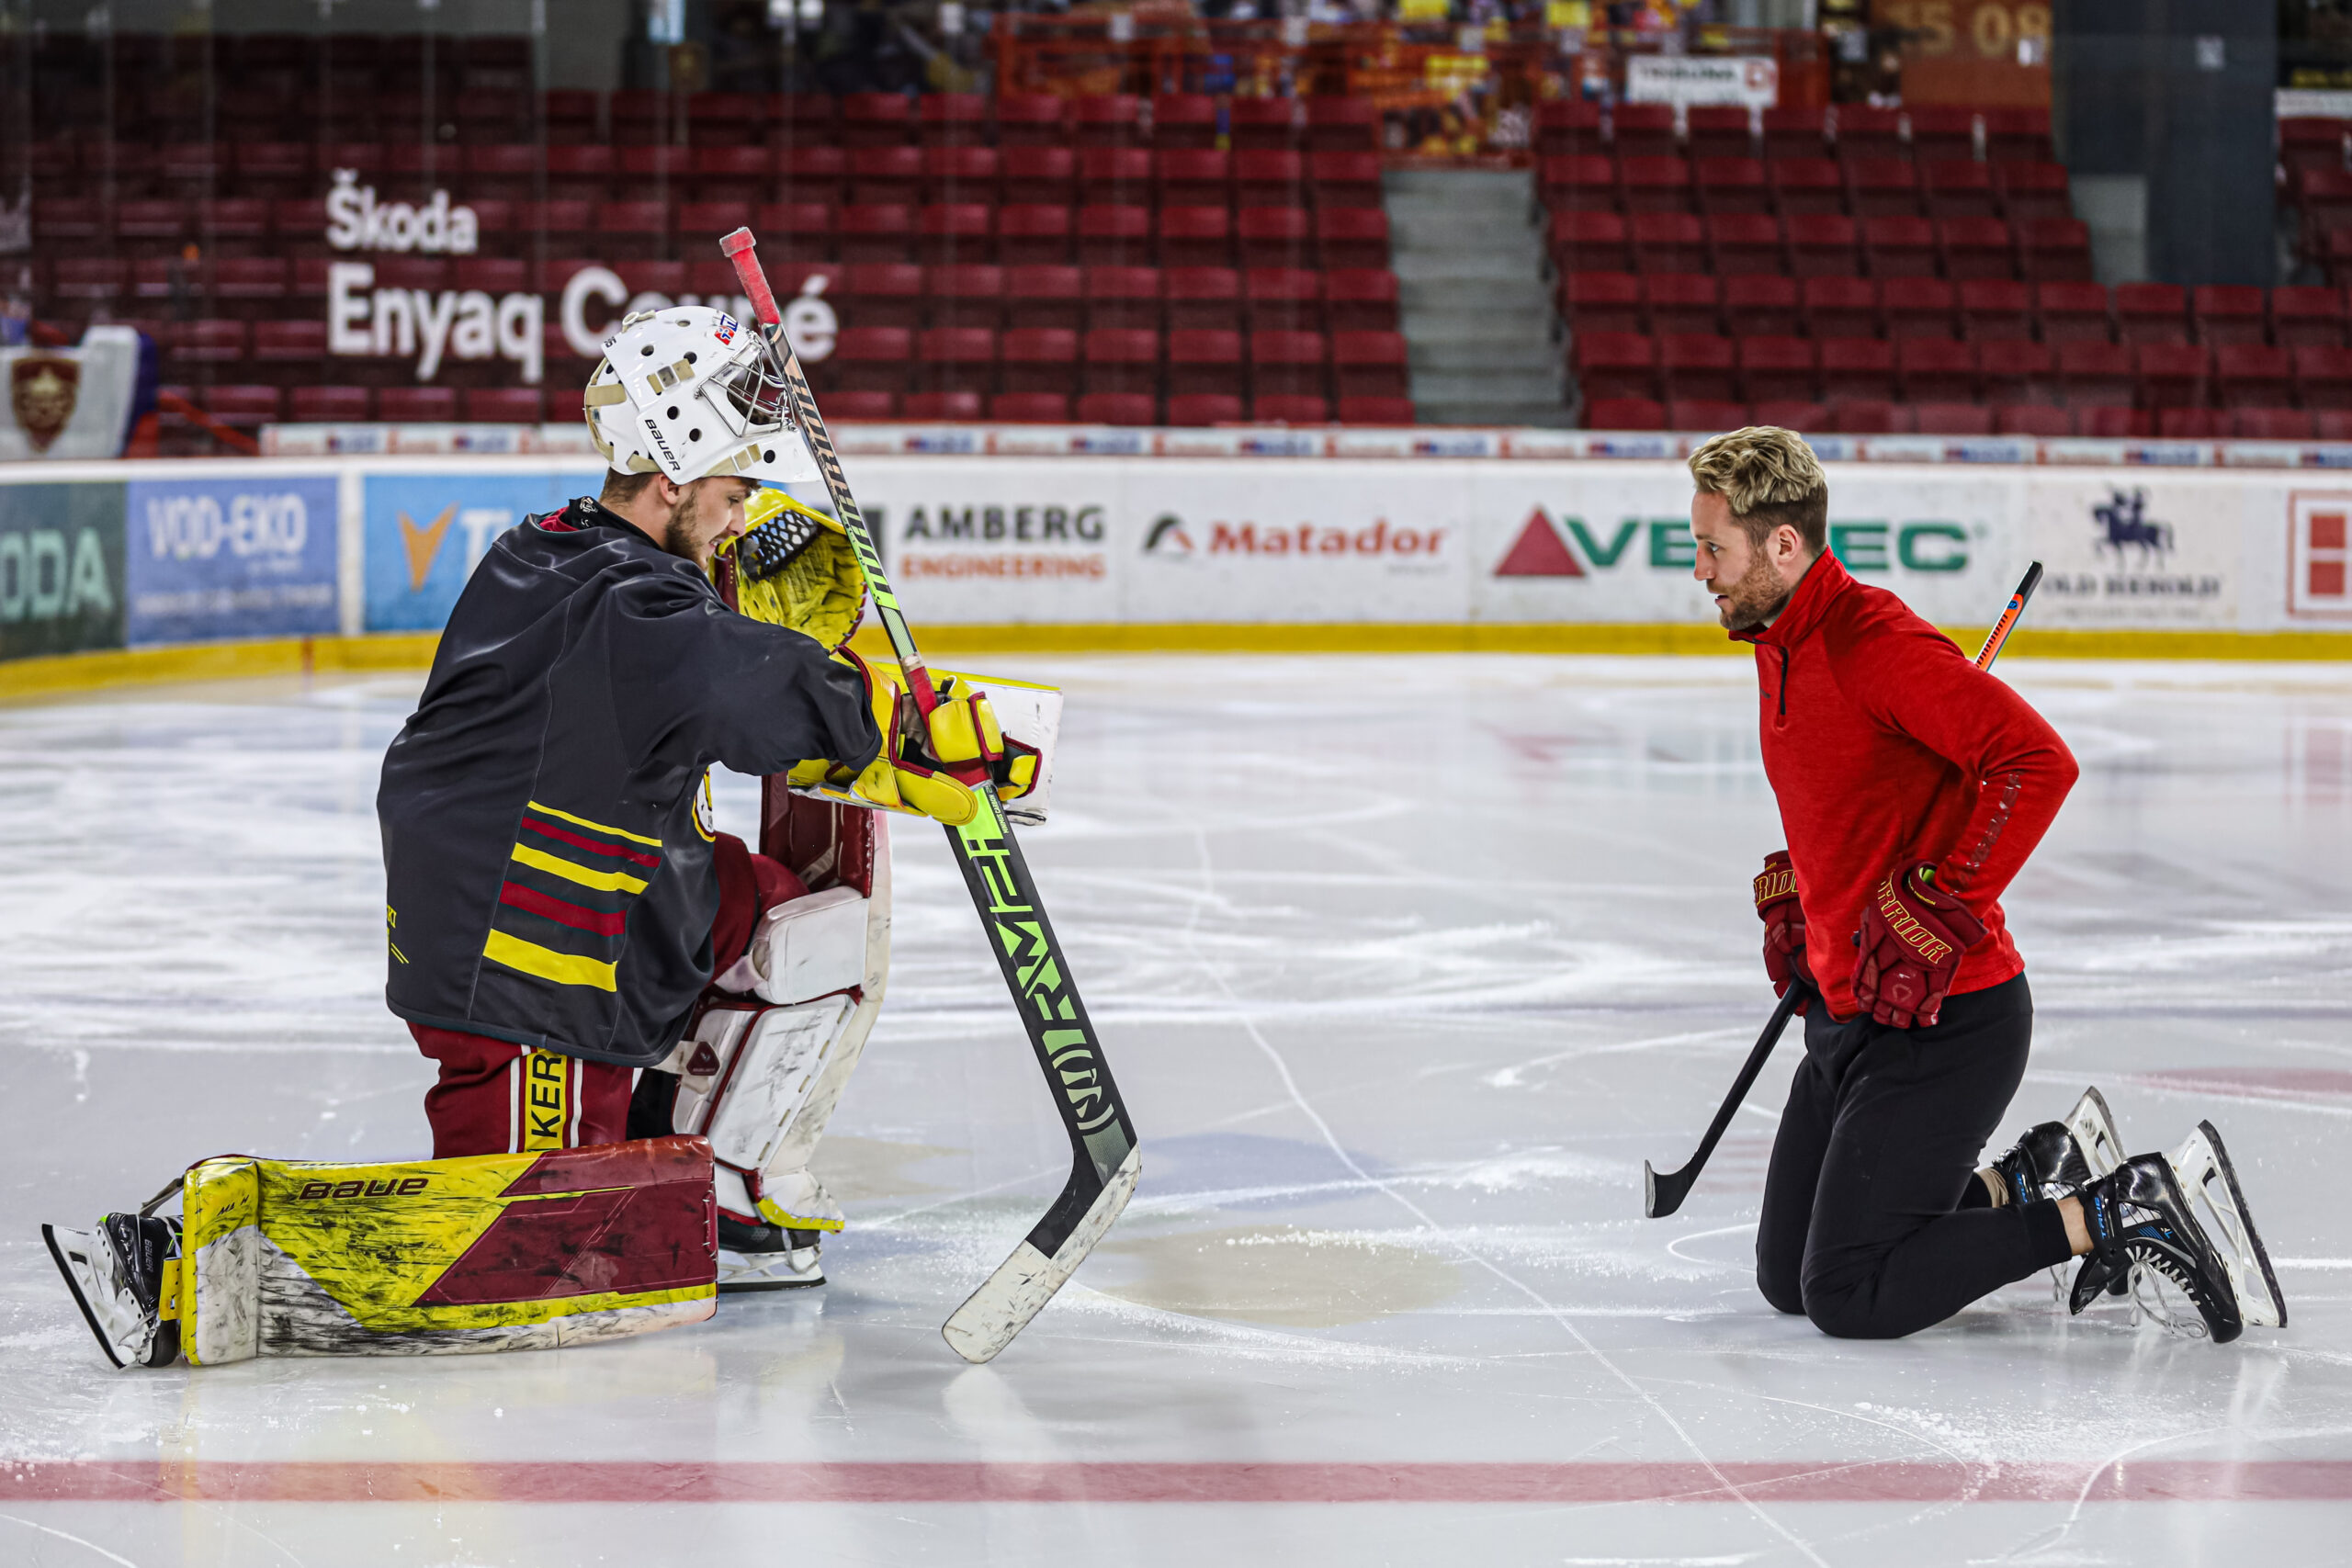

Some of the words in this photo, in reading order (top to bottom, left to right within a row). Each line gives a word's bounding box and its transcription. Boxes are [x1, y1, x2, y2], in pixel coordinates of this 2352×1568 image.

[326, 169, 478, 254] Škoda
[328, 261, 545, 382] Enyaq
[645, 419, 681, 471] BAUER
[146, 493, 308, 559] VOD-EKO
[905, 507, 1105, 540] AMBERG
[1208, 516, 1447, 556] Matador
[901, 555, 1105, 578] ENGINEERING
[1877, 879, 1953, 964] RRIOR
[527, 1053, 563, 1152] KER
